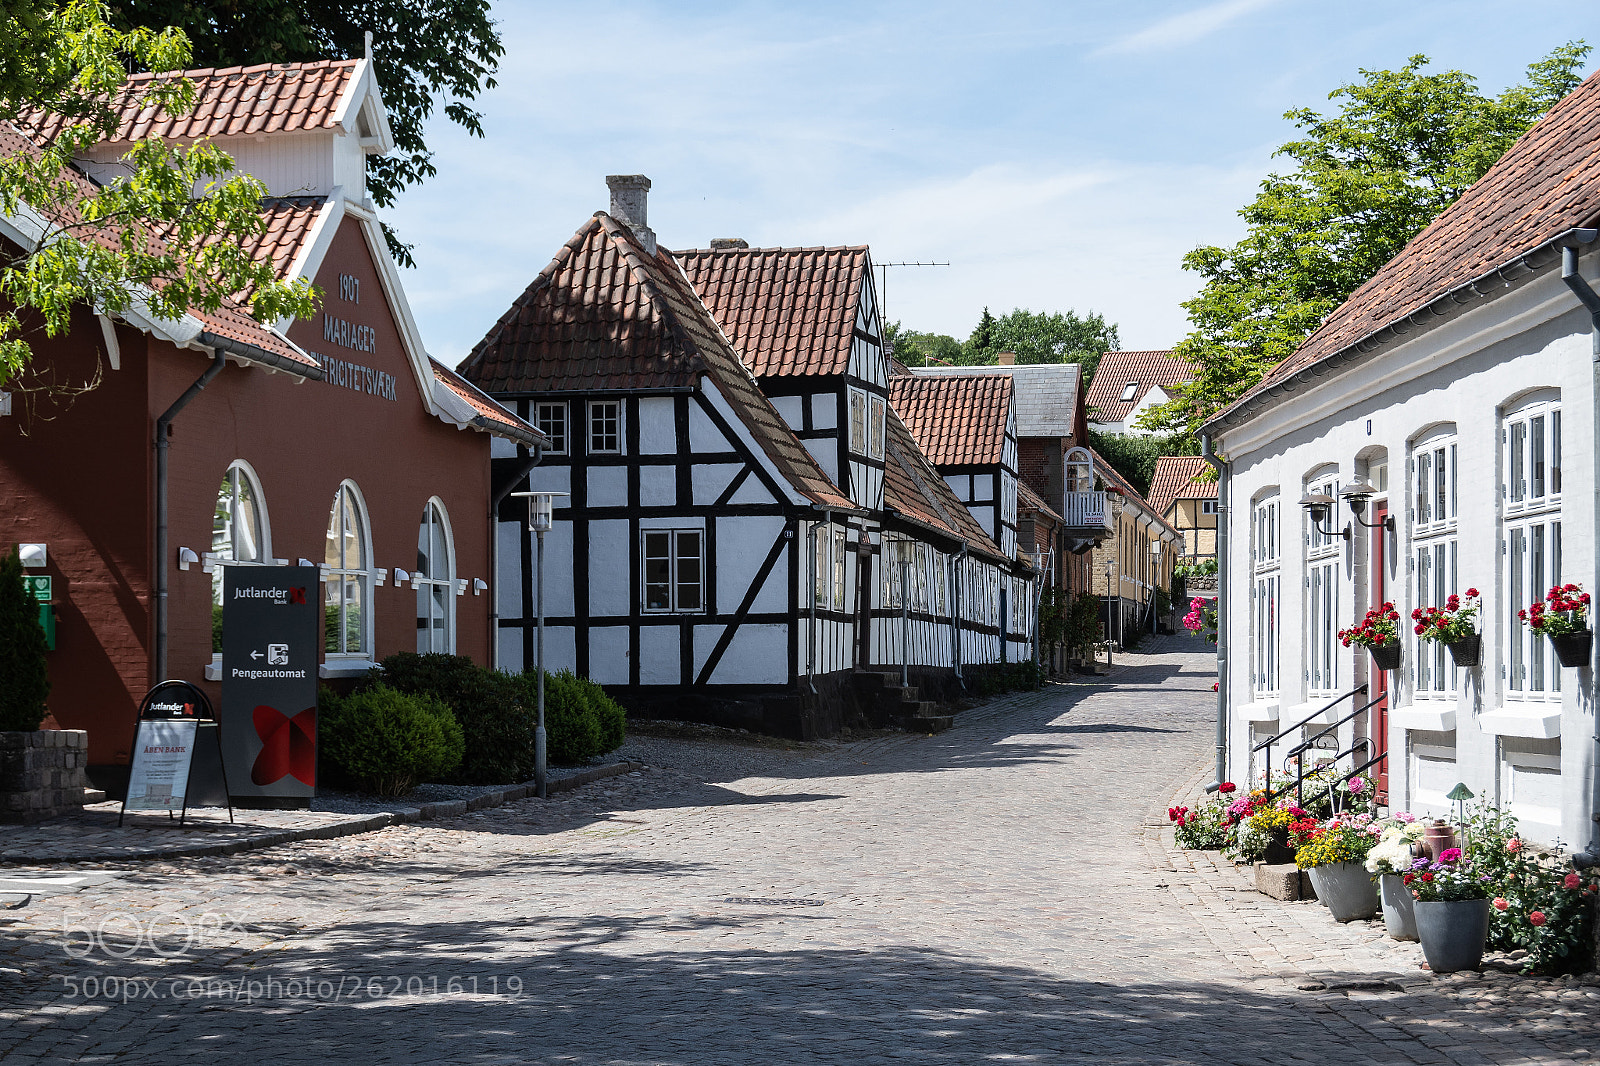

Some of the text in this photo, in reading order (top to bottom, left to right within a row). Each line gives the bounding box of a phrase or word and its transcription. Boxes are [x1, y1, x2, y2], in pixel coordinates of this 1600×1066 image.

[339, 273, 359, 304] 1907
[234, 586, 287, 599] Jutlander
[232, 668, 305, 679] Pengeautomat
[149, 702, 183, 711] Jutlander
